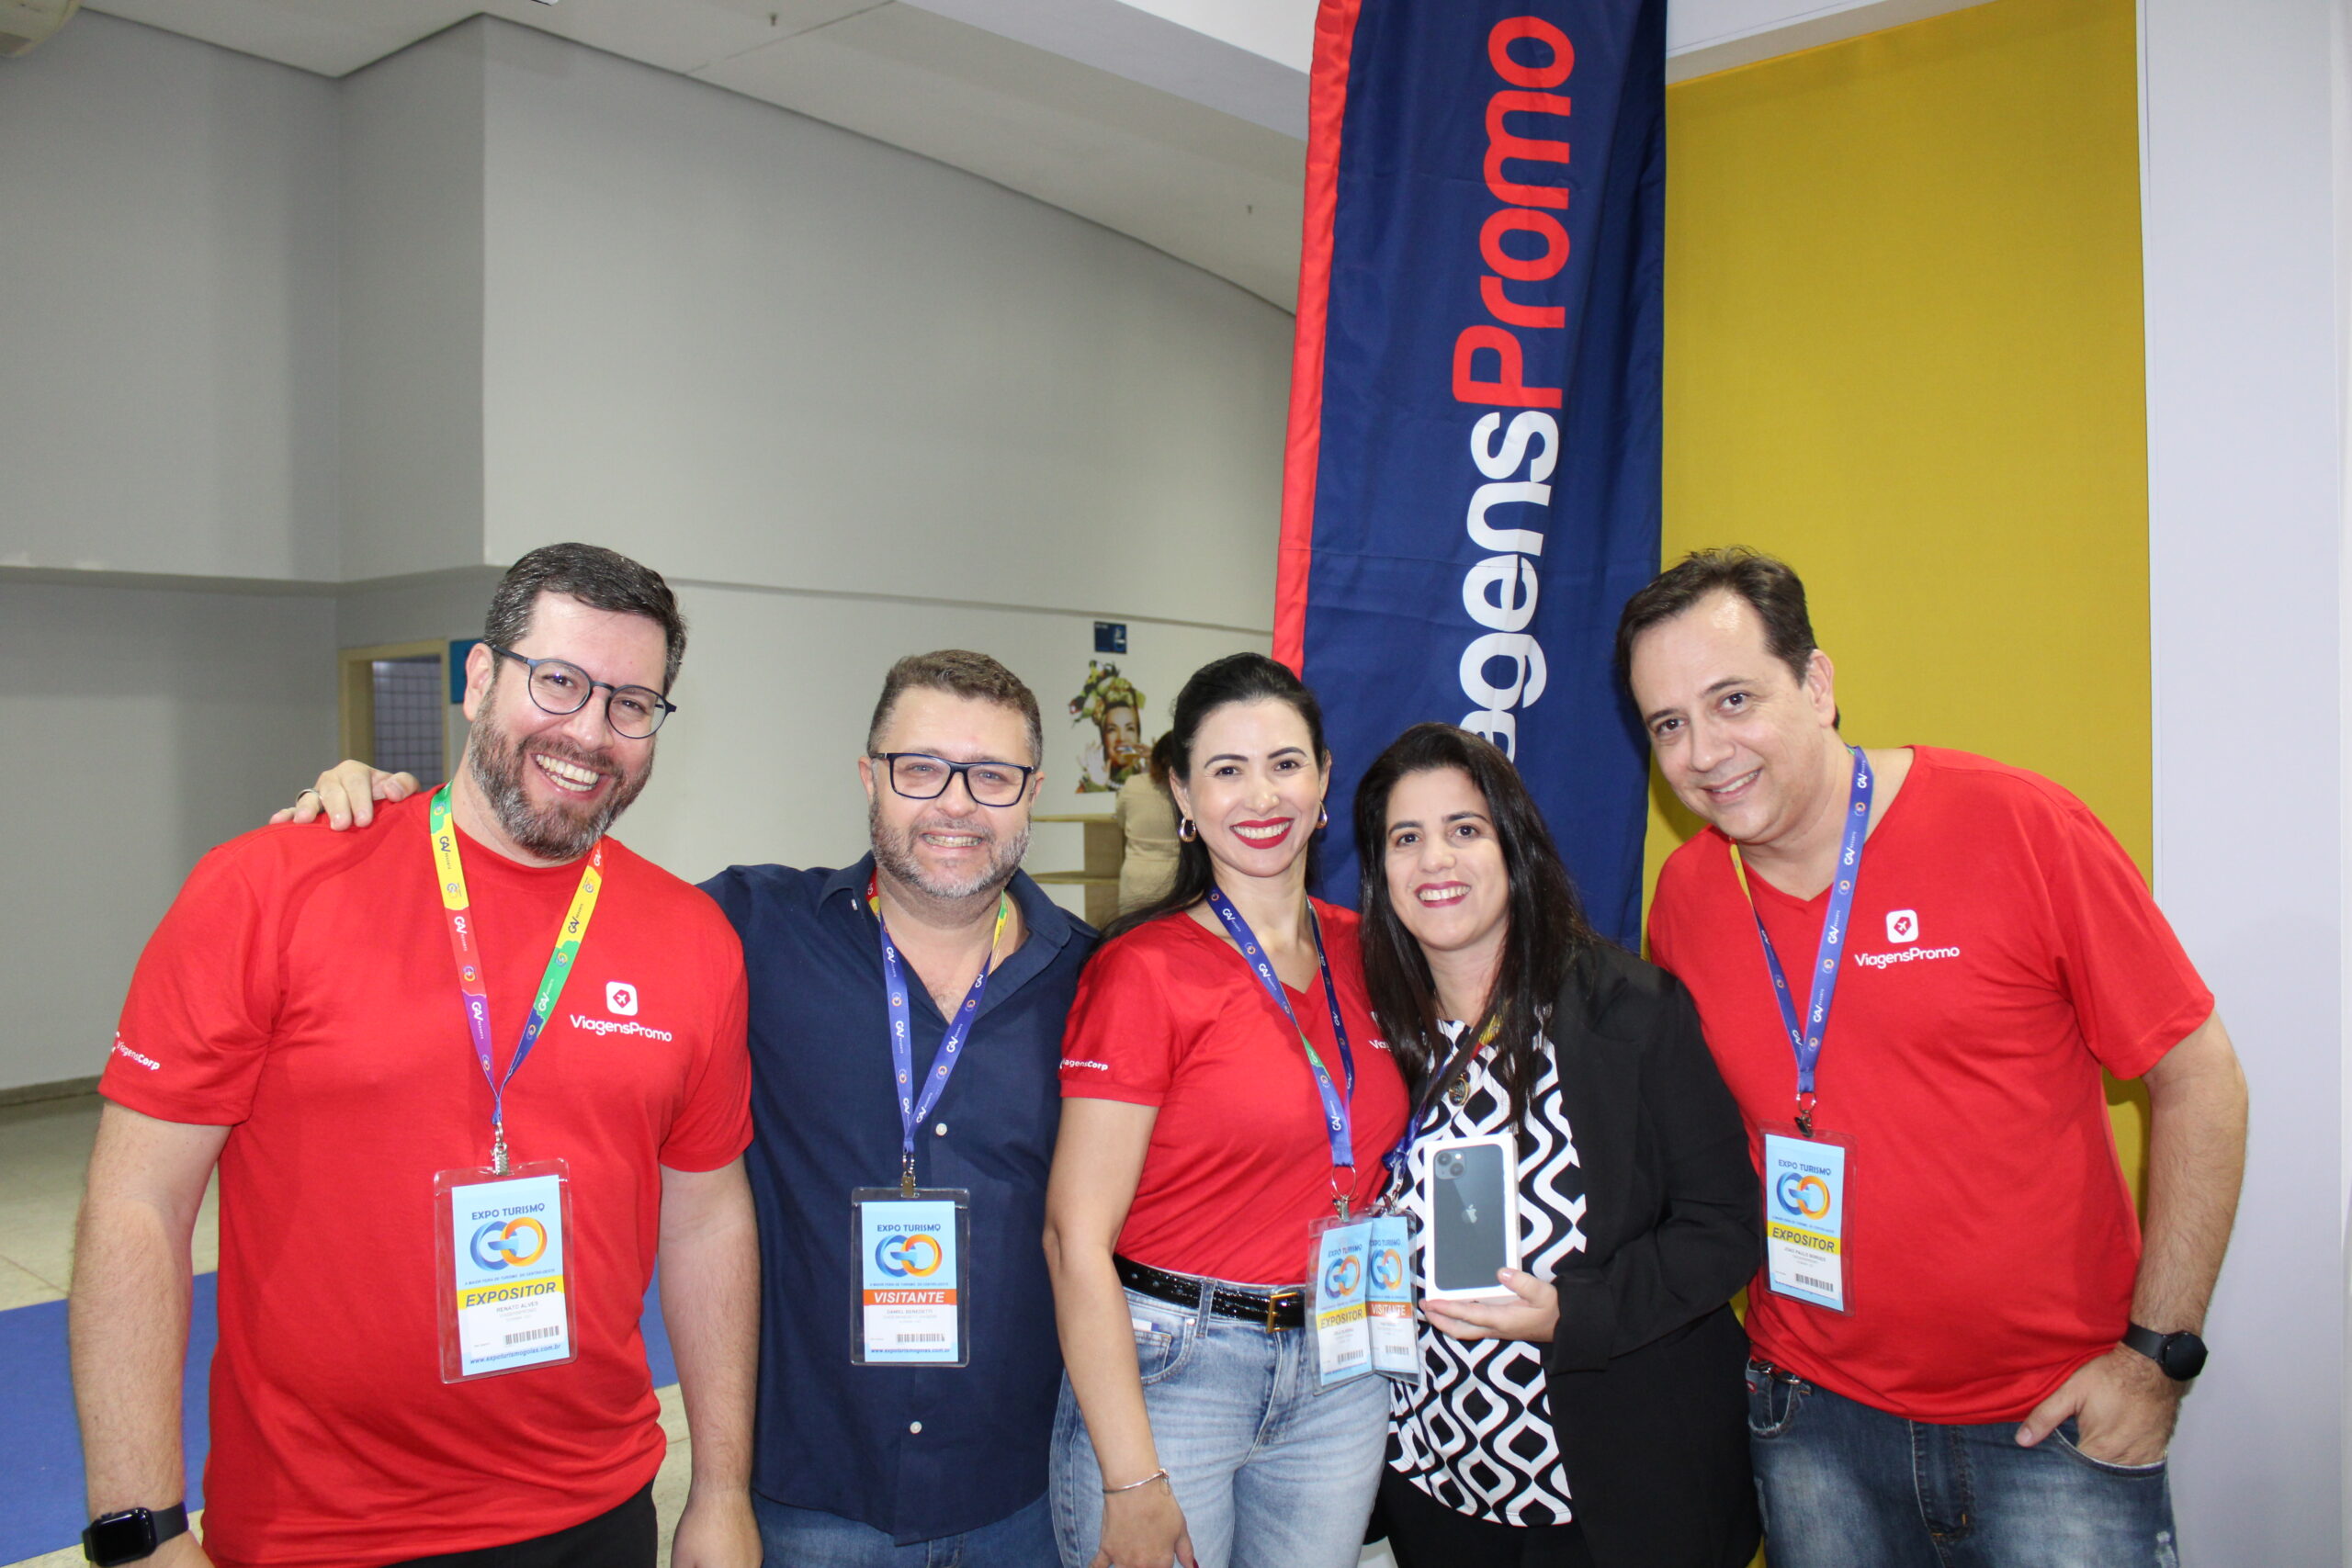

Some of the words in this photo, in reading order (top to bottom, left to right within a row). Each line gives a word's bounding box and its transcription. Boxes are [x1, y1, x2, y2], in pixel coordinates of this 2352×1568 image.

[1452, 16, 1575, 764] agensPromo
[1857, 773, 1868, 789] GAV
[1844, 847, 1855, 865] GAV
[1222, 908, 1236, 920] GAV
[454, 916, 468, 934] GAV
[1827, 925, 1839, 944] GAV
[1854, 946, 1960, 969] ViagensPromo
[1259, 963, 1271, 977] GAV
[471, 1001, 484, 1021] GAV
[1813, 1004, 1824, 1023] GAV
[570, 1014, 673, 1042] ViagensPromo
[896, 1021, 904, 1038] GAV
[946, 1036, 958, 1053] GAV
[1331, 1114, 1341, 1131] GAV
[1778, 1159, 1798, 1170] EXPO
[1800, 1163, 1831, 1177] TURISMO
[471, 1209, 500, 1221] EXPO
[503, 1202, 546, 1218] TURISMO
[903, 1224, 941, 1232] TURISMO
[1772, 1226, 1835, 1253] EXPOSITOR
[466, 1281, 556, 1307] EXPOSITOR
[874, 1292, 945, 1303] VISITANTE
[1320, 1308, 1363, 1328] EXPOSITOR
[1371, 1303, 1406, 1316] VISITANTE
